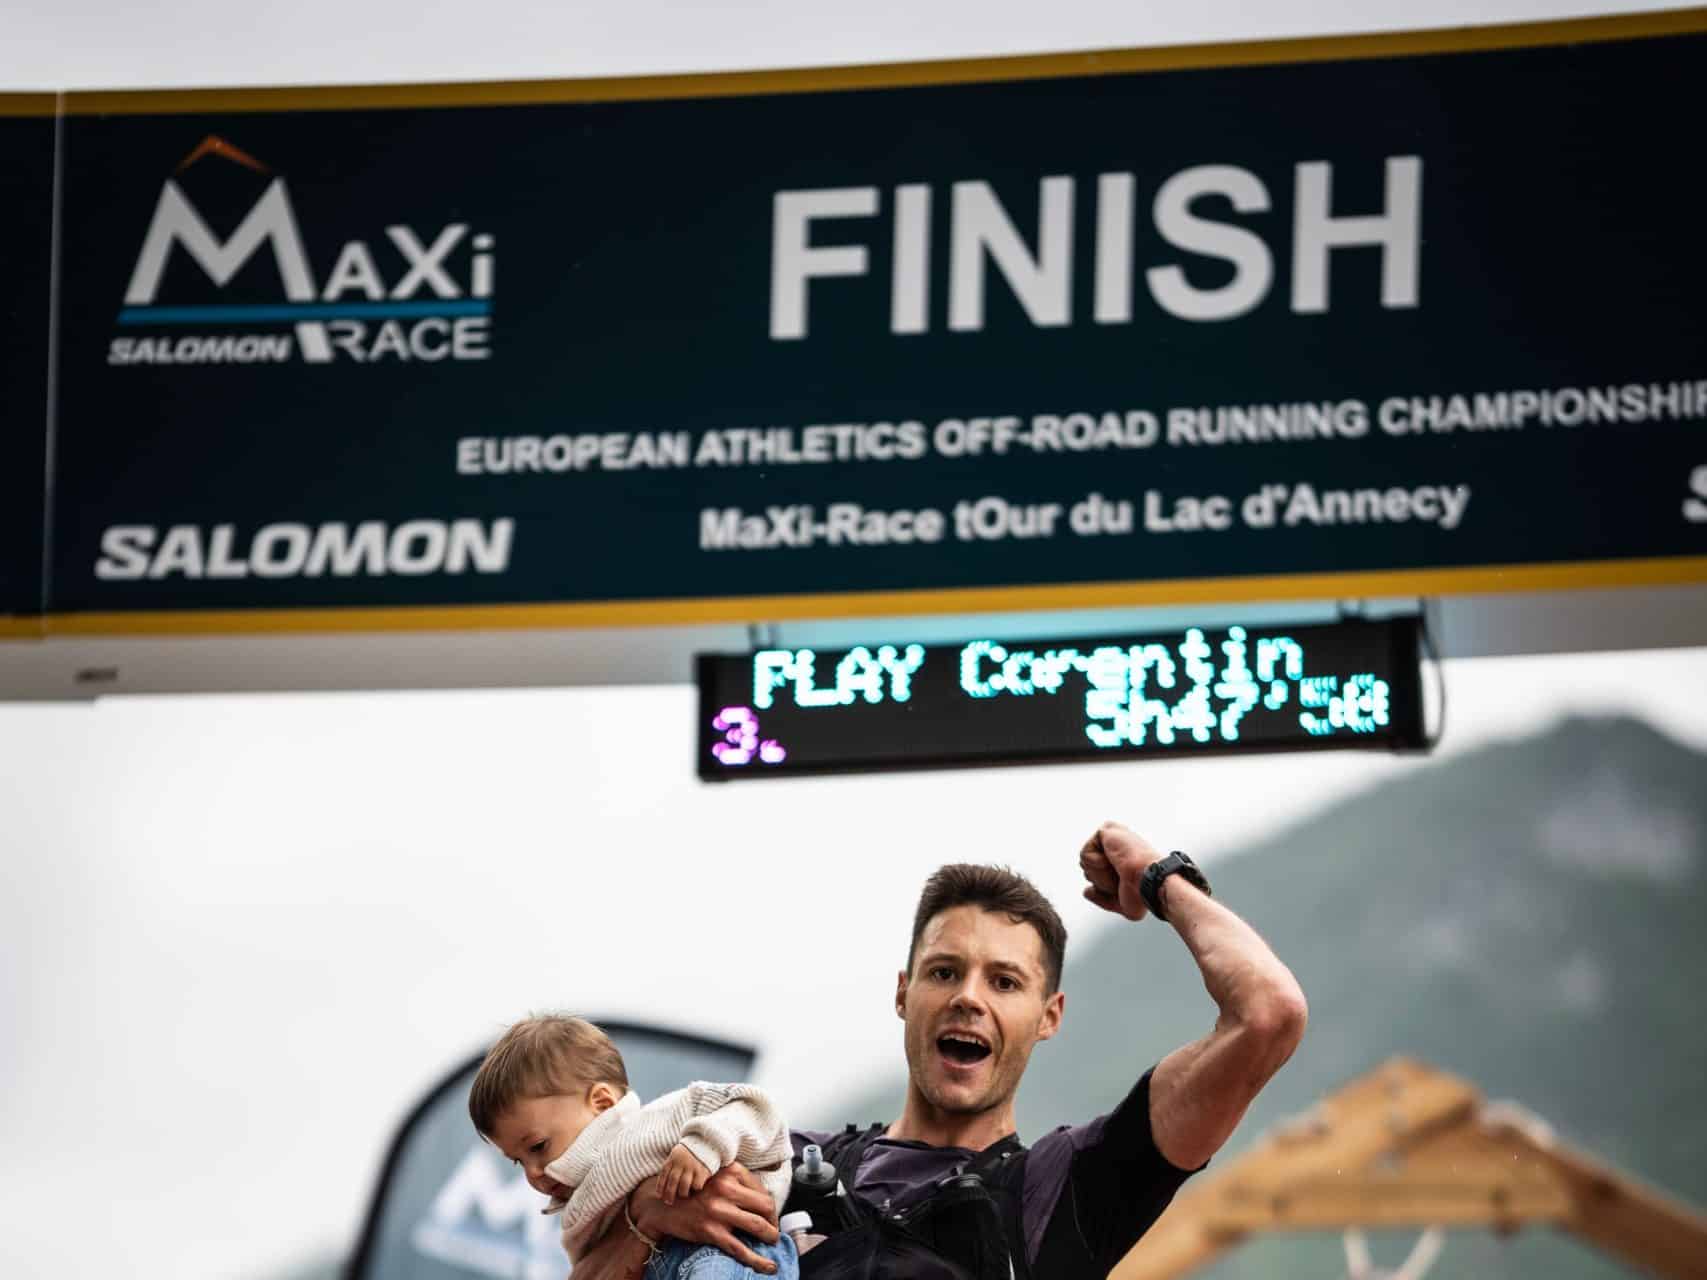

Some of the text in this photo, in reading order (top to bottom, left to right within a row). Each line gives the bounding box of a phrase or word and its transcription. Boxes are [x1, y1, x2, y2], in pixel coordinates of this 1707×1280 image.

[770, 157, 1422, 340] FINISH
[108, 317, 490, 363] SALOMON RACE
[456, 432, 690, 474] EUROPEAN
[694, 421, 927, 466] ATHLETICS
[933, 410, 1159, 456] OFF-ROAD
[1167, 400, 1369, 445] RUNNING
[95, 517, 514, 579] SALOMON
[699, 482, 1469, 549] MaXi-Race tOur du Lac d'Annecy
[753, 626, 1302, 709] PLAY Corentin
[712, 706, 786, 765] 3.
